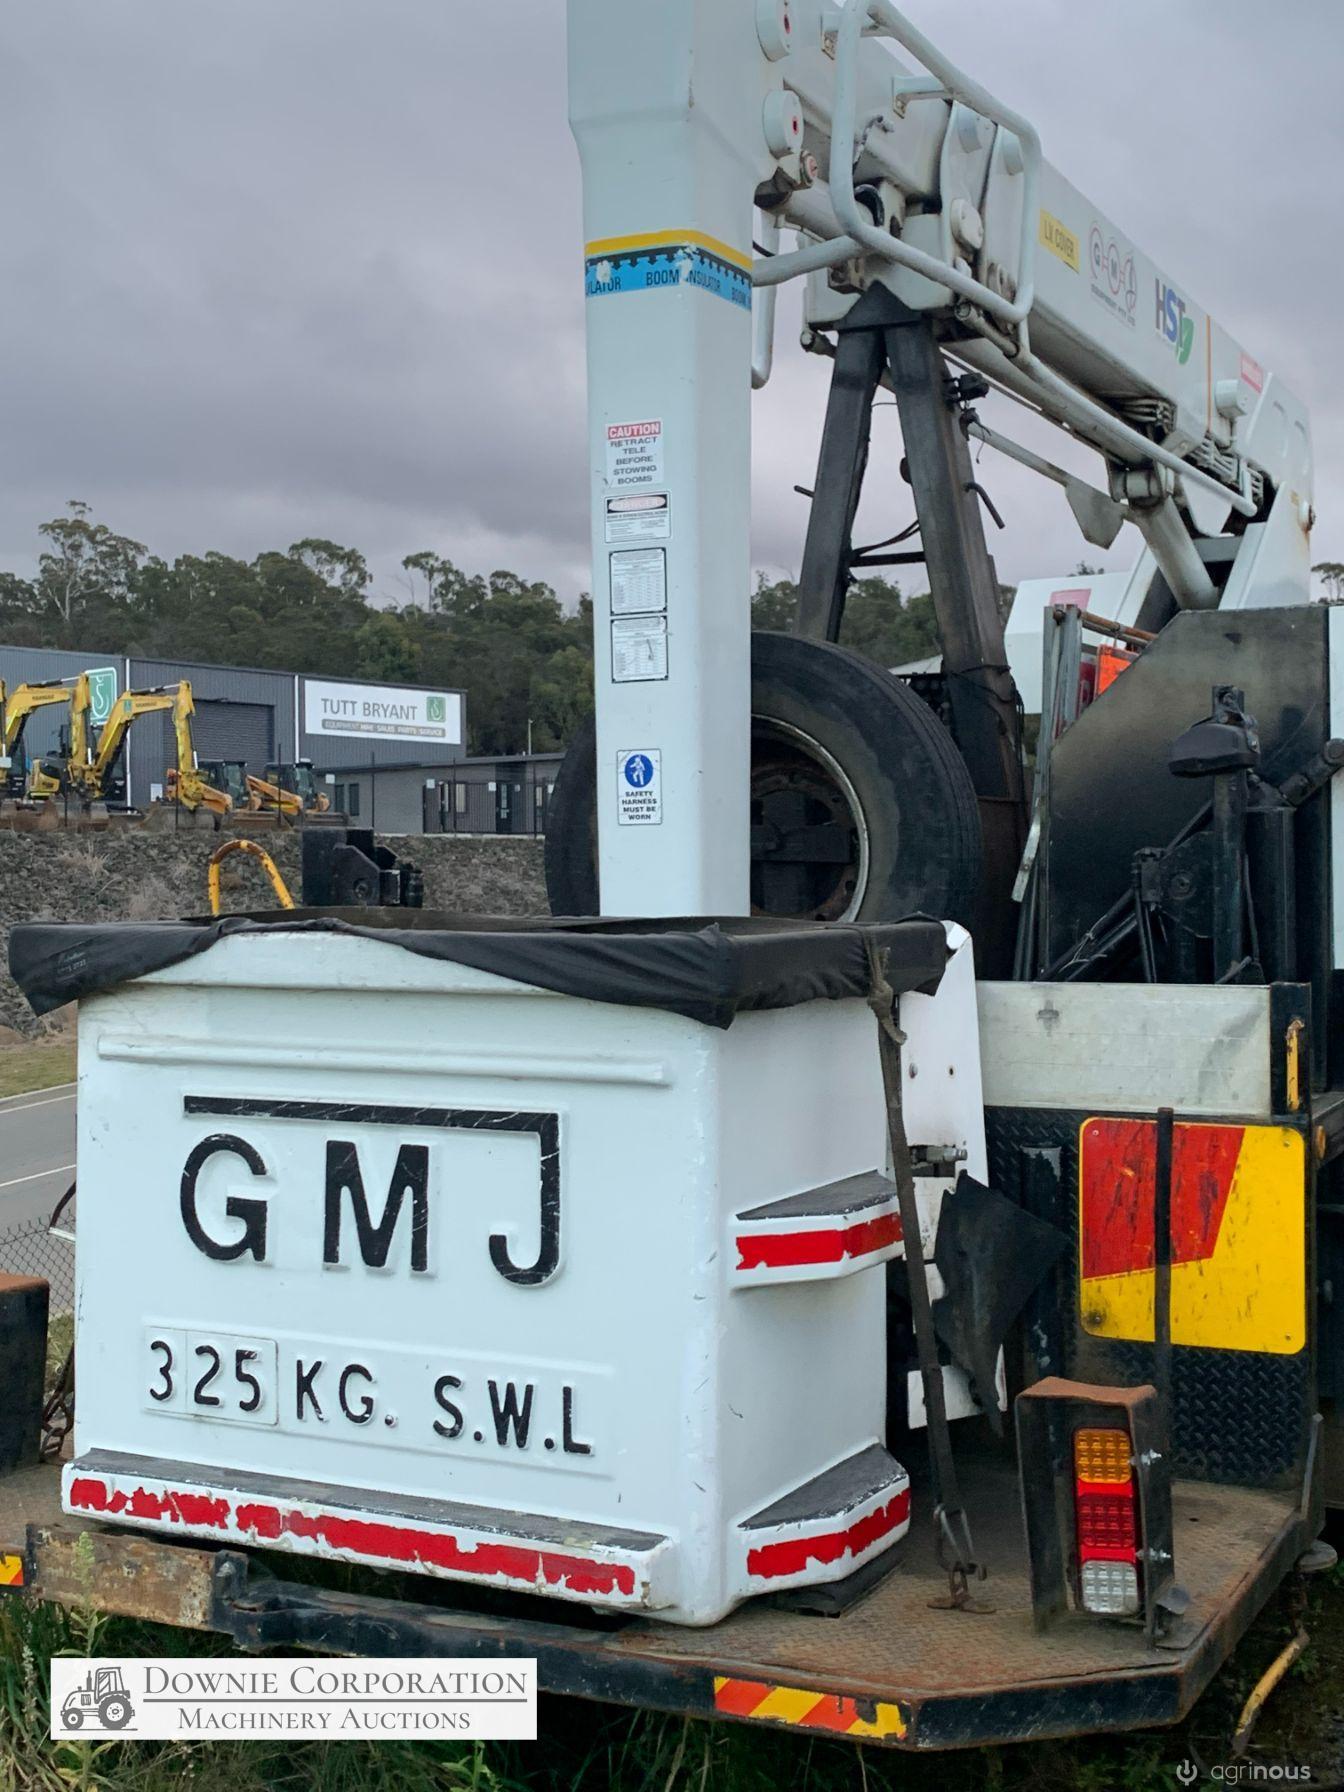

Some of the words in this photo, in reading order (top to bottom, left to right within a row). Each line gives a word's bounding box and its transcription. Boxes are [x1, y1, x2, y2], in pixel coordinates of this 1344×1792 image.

[646, 269, 680, 287] BOOM
[1155, 278, 1186, 349] HST
[609, 422, 660, 438] CAUTION
[610, 436, 658, 447] RETRACT
[623, 446, 646, 455] TELE
[615, 456, 654, 465] BEFORE
[613, 465, 657, 475] STOWING
[617, 475, 653, 485] BOOMS
[321, 697, 358, 716] TUTT
[362, 701, 418, 721] BRYANT
[149, 1340, 262, 1412] 325
[296, 1359, 398, 1427] KG.
